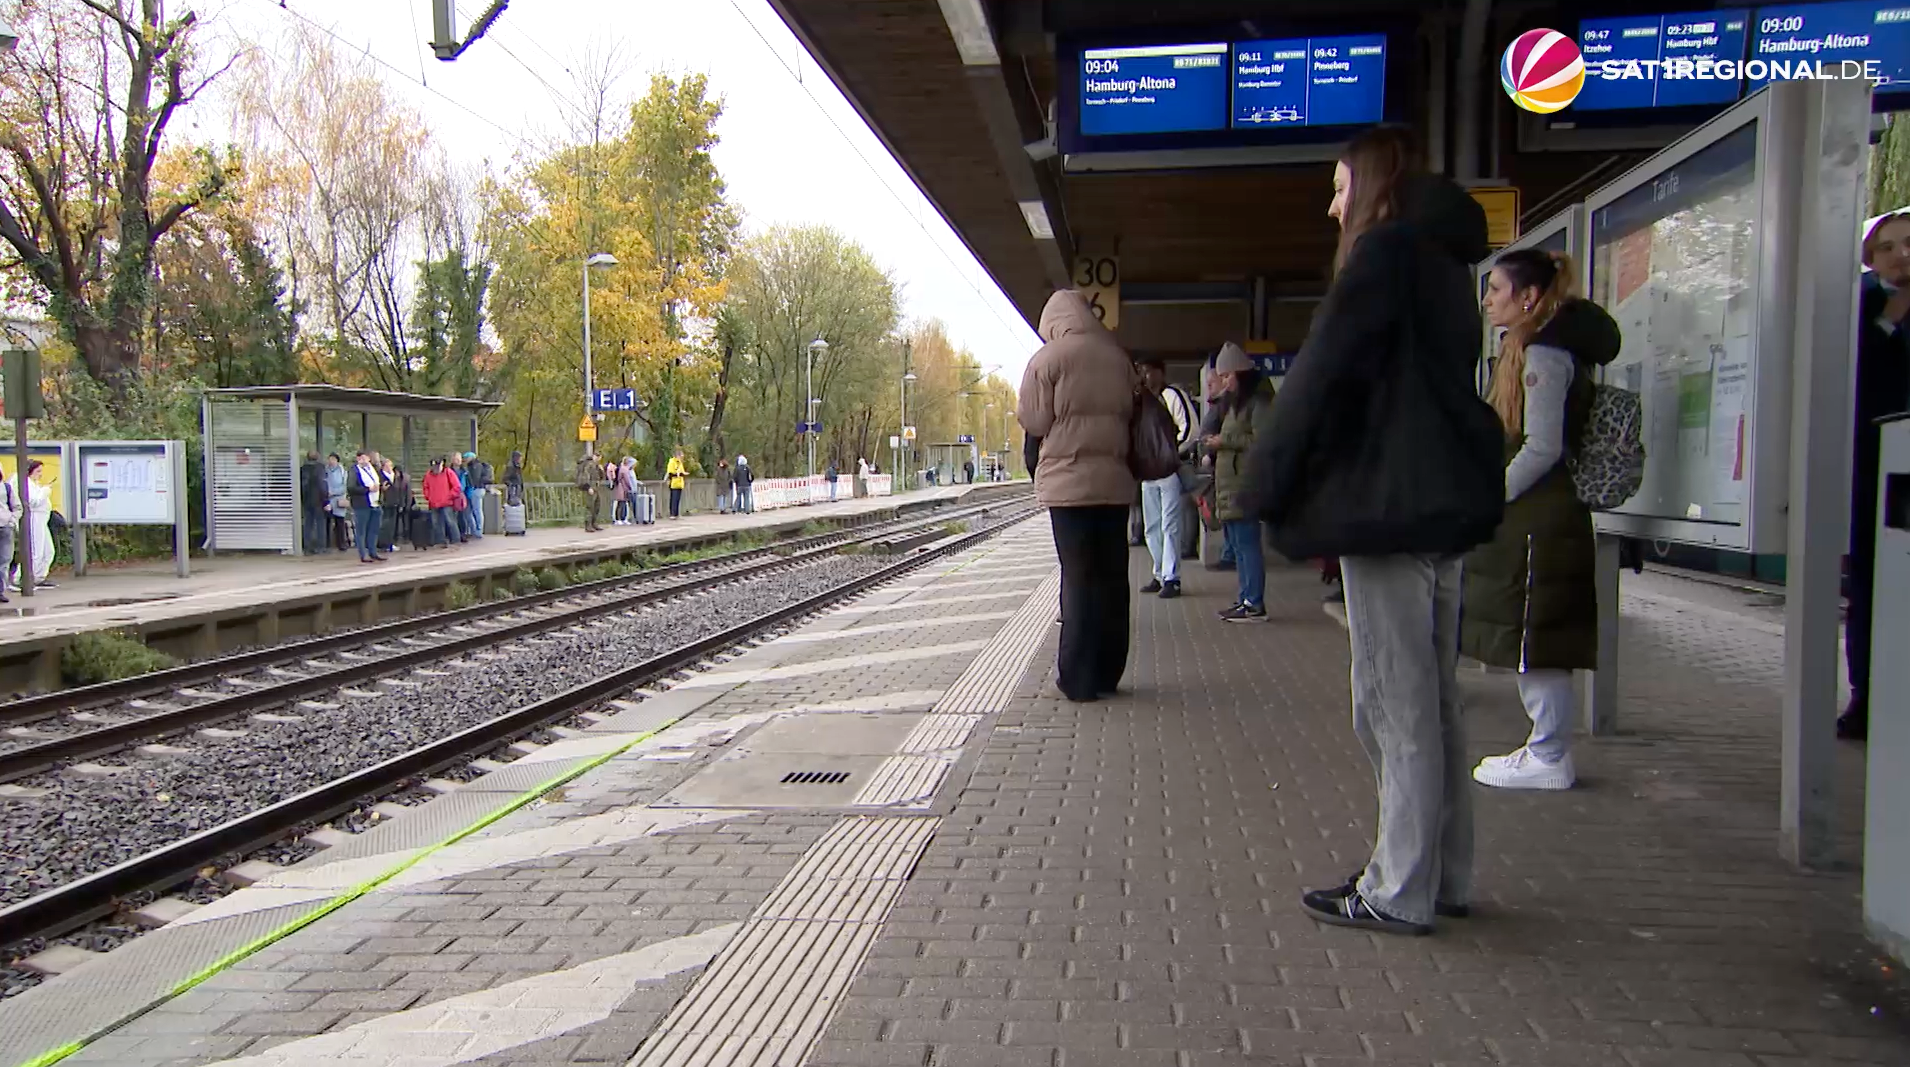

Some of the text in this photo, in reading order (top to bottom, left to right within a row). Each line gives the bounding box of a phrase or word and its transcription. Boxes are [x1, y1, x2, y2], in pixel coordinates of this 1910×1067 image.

[1667, 24, 1692, 35] 09:23
[1761, 16, 1803, 33] 09:00
[1585, 31, 1610, 40] 09:47
[1666, 38, 1702, 48] Hamburg
[1758, 34, 1870, 54] Hamburg-Altona
[1238, 52, 1262, 62] 09:11
[1313, 48, 1337, 58] 09:42
[1085, 60, 1119, 74] 09:04
[1238, 66, 1271, 75] Hamburg
[1085, 76, 1176, 94] Hamburg-Altona
[1652, 170, 1680, 202] Tarife
[1076, 257, 1118, 288] 30
[1091, 292, 1106, 322] 6
[600, 390, 635, 408] E 1
